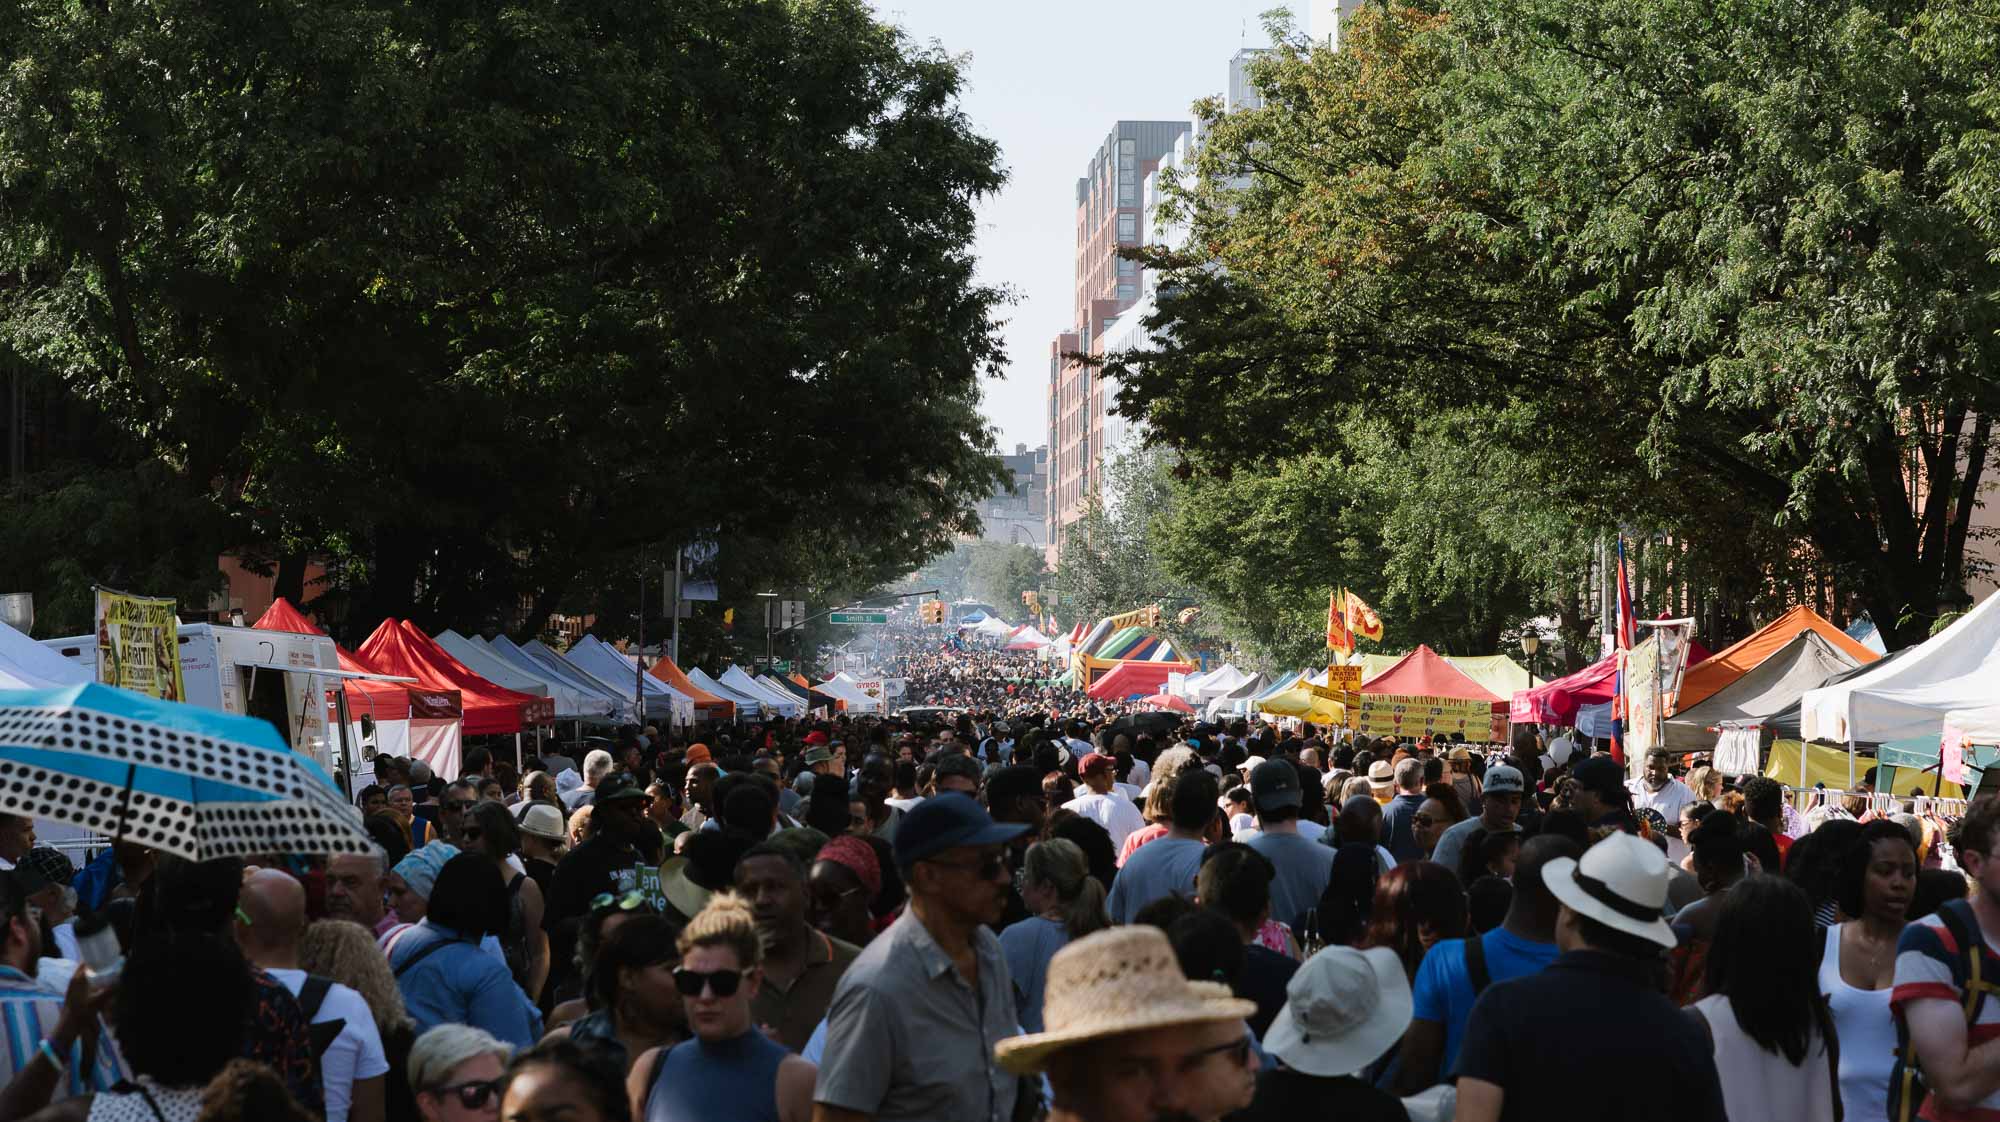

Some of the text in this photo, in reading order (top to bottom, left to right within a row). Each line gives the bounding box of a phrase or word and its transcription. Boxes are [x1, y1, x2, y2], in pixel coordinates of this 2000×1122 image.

[856, 681, 880, 689] GYROS
[1368, 694, 1385, 702] NEW
[1388, 695, 1411, 704] YORK
[1413, 696, 1440, 706] CANDY
